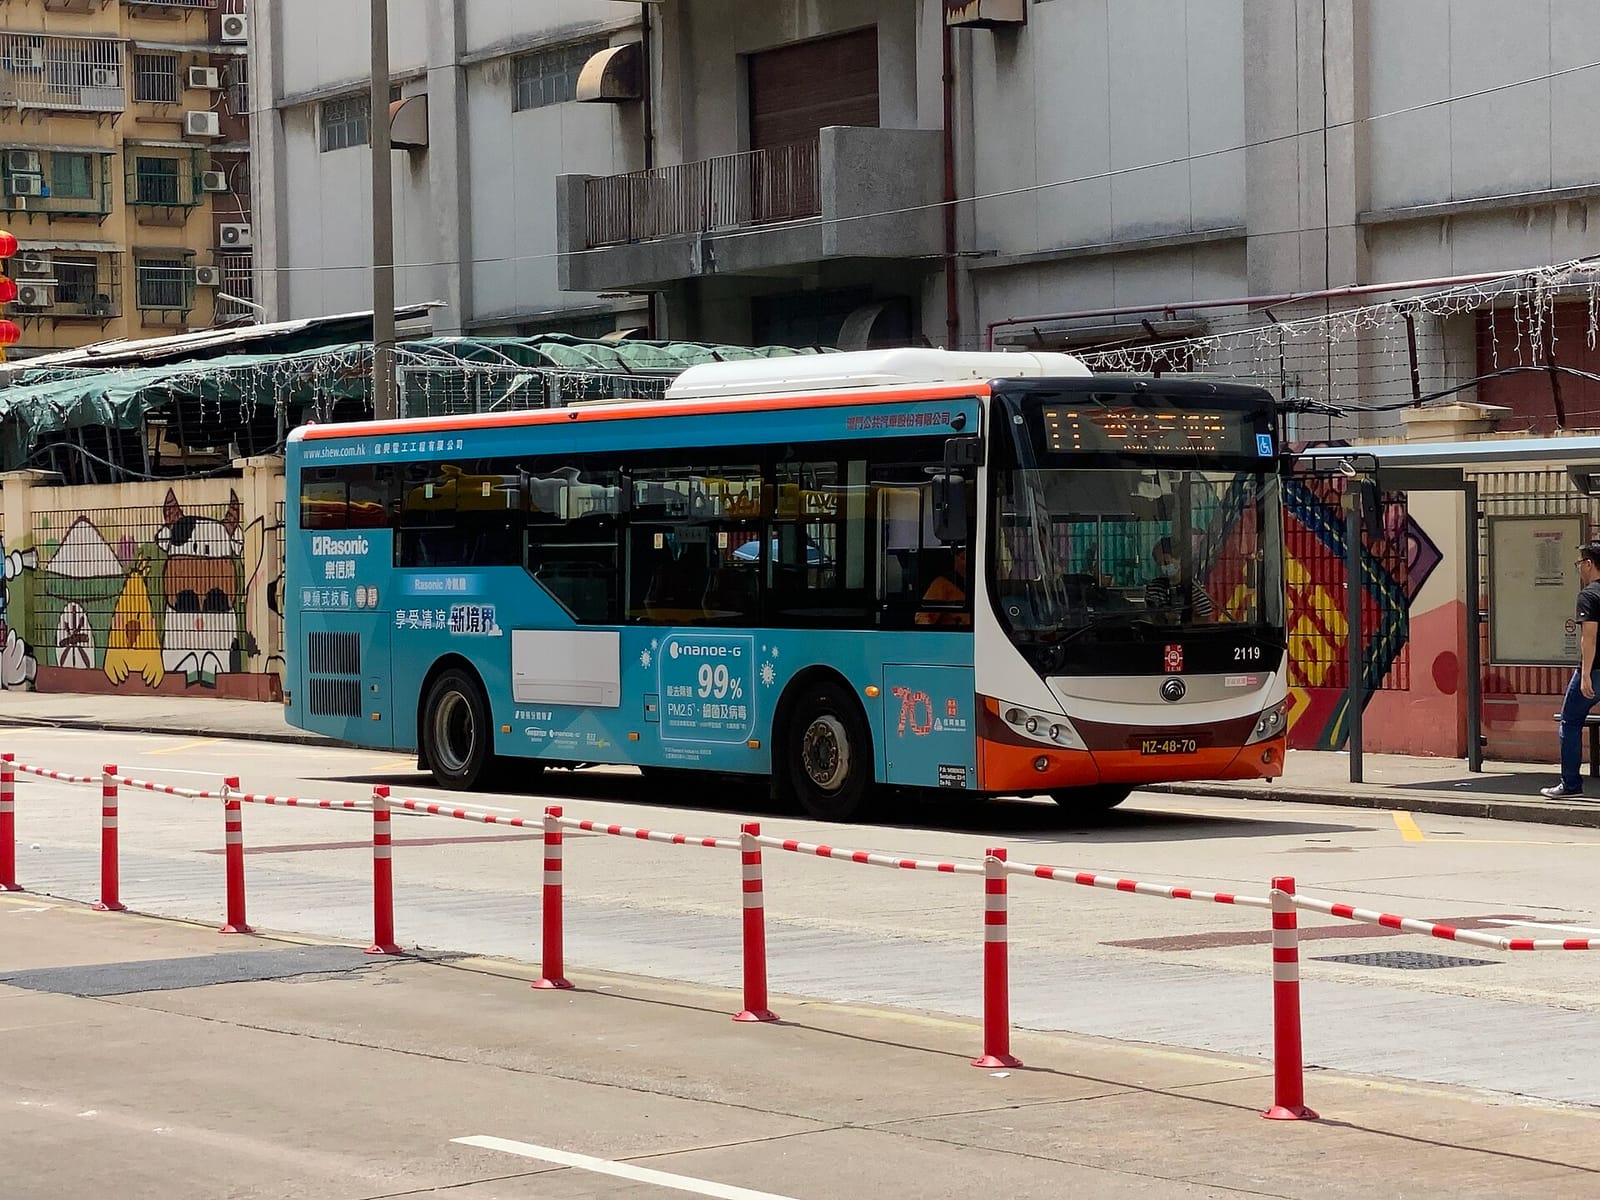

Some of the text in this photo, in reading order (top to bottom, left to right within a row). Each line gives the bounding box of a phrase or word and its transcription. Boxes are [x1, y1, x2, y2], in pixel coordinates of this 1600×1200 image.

[303, 444, 366, 459] www.shew.com.hk
[323, 535, 368, 555] Rasonic
[325, 560, 356, 579] 樂信牌
[415, 579, 443, 590] Rasonic
[395, 606, 495, 633] 享受清涼 新境界
[684, 645, 742, 657] nanoe-G
[1234, 646, 1260, 660] 2119
[698, 663, 743, 700] 99%
[891, 687, 932, 737] 70
[1142, 740, 1196, 753] MZ-48-70
